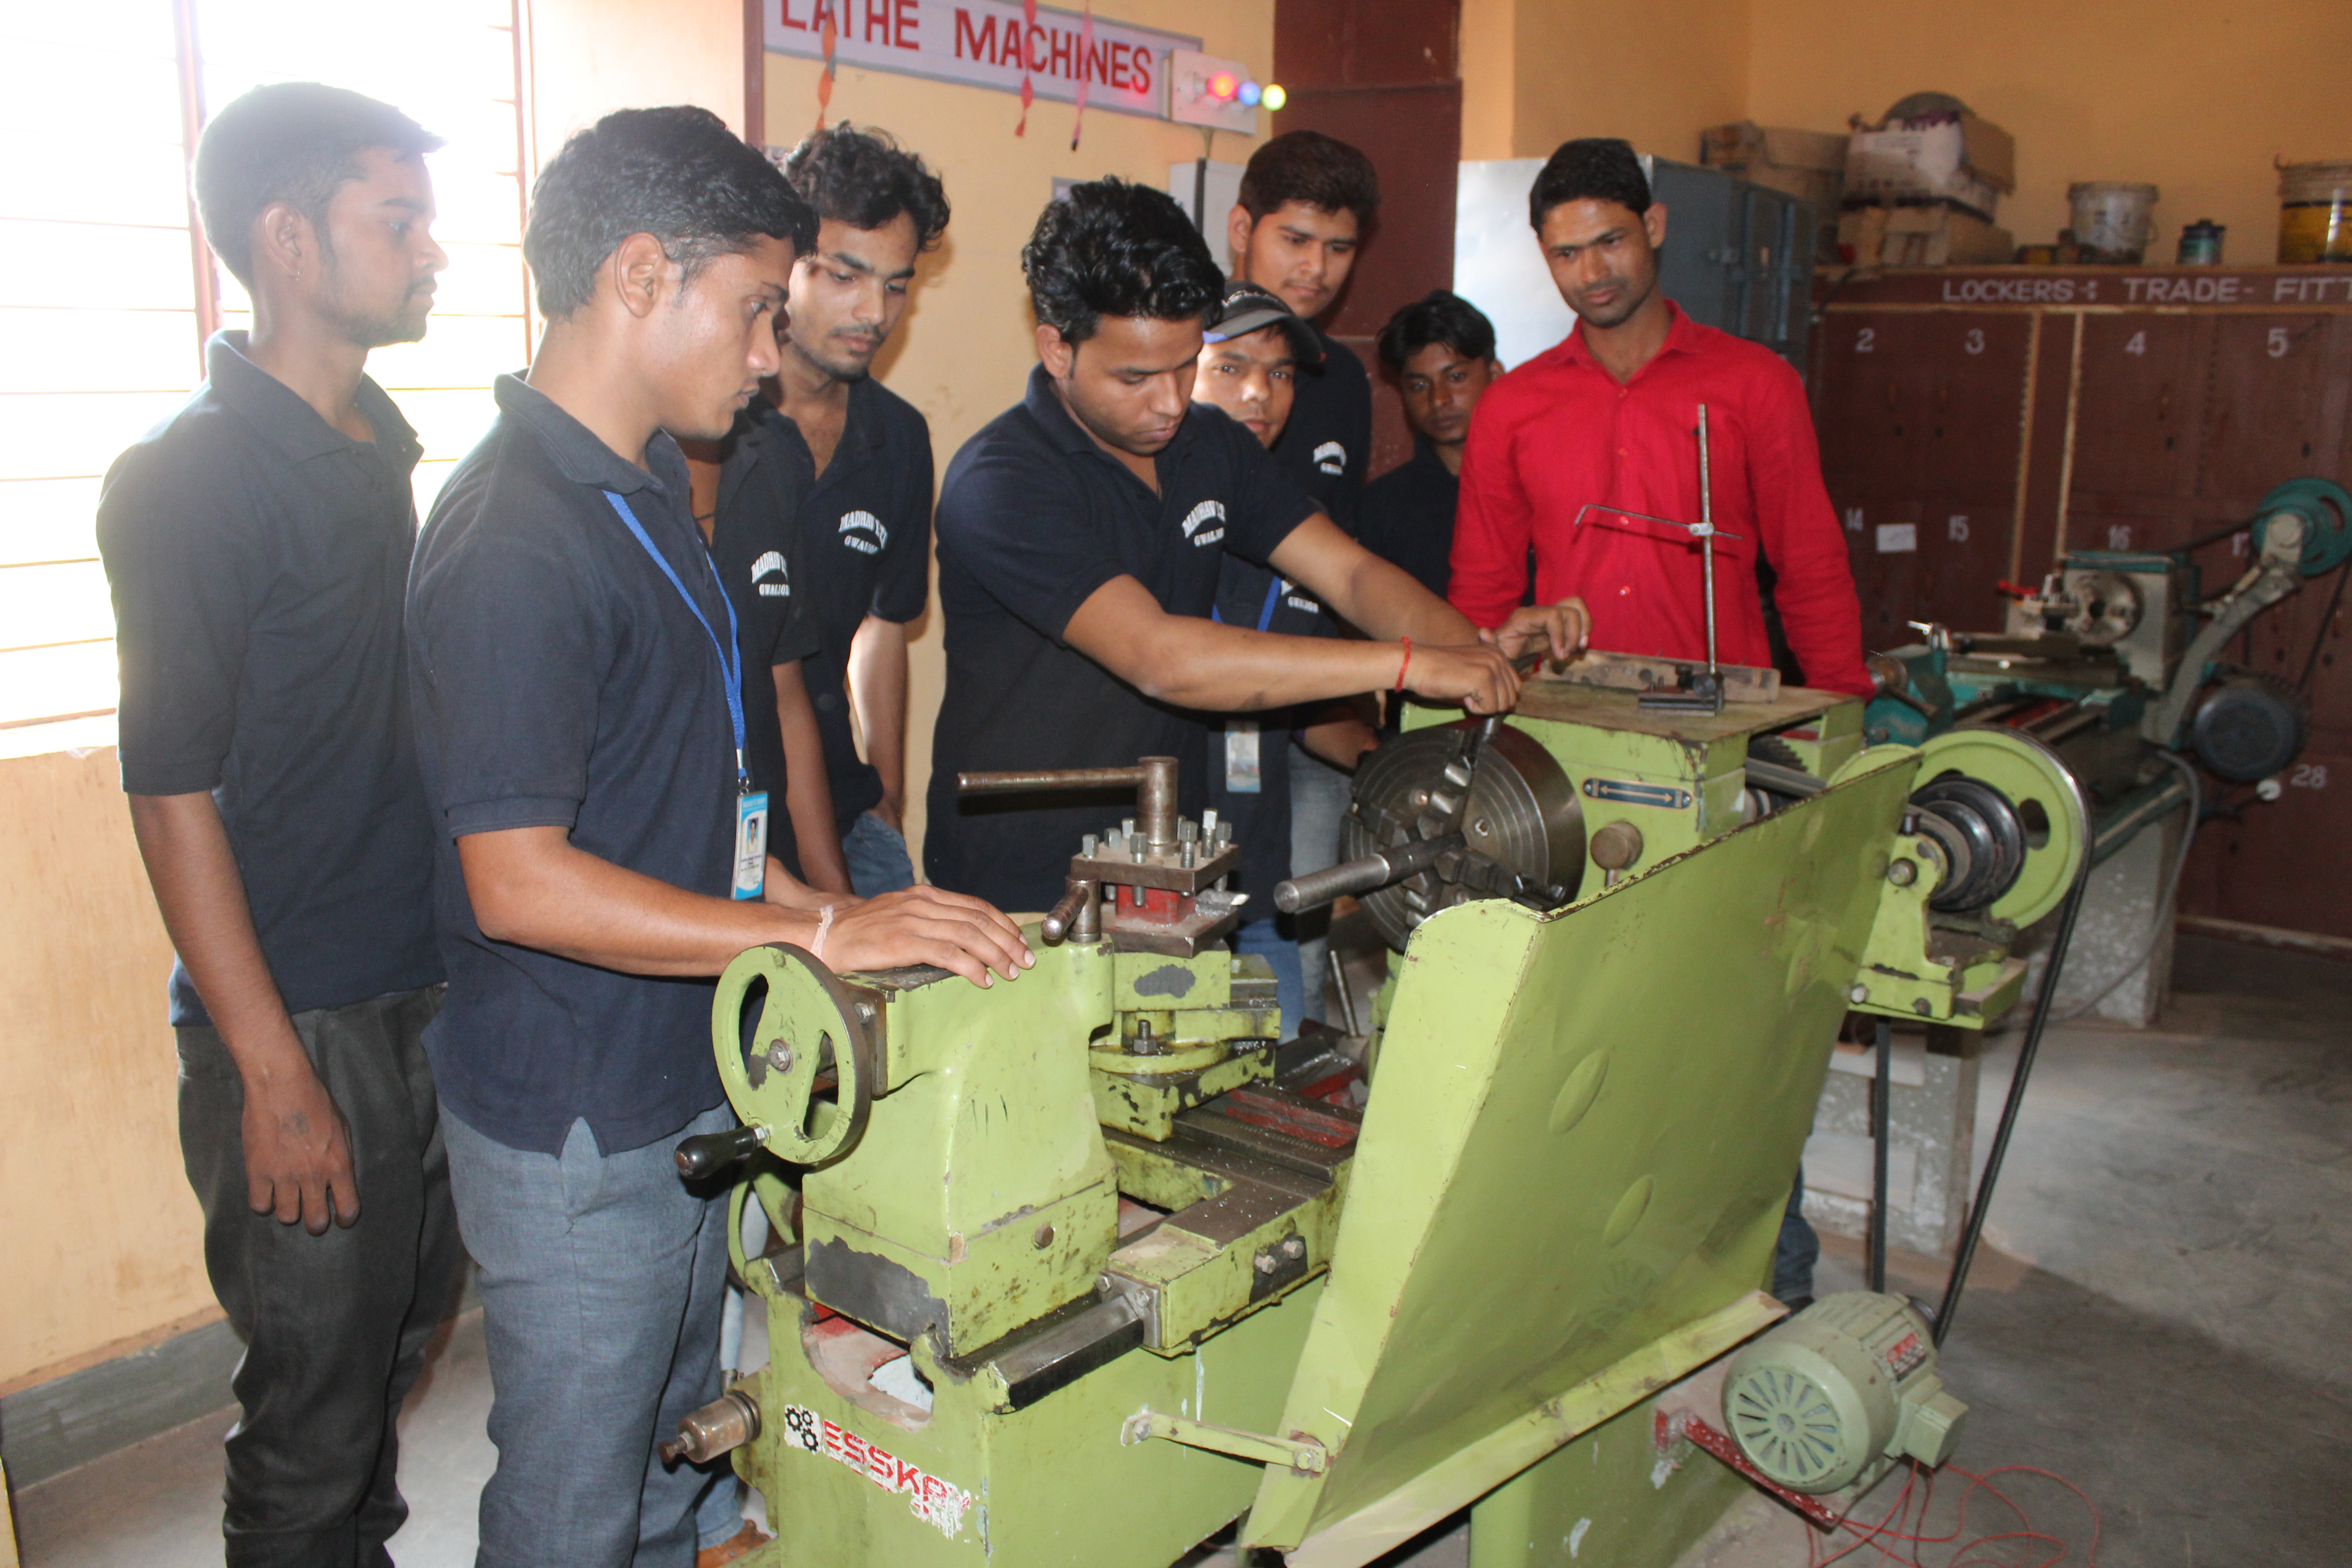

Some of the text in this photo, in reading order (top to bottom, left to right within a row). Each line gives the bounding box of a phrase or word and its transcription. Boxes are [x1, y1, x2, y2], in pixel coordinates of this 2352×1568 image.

[954, 8, 1152, 93] MACHINES
[1856, 328, 1875, 353] 2
[1965, 328, 1985, 354] 3
[2125, 331, 2146, 356] 4
[2268, 328, 2289, 358] 5
[1949, 515, 1969, 541] 15
[2290, 764, 2327, 789] 28
